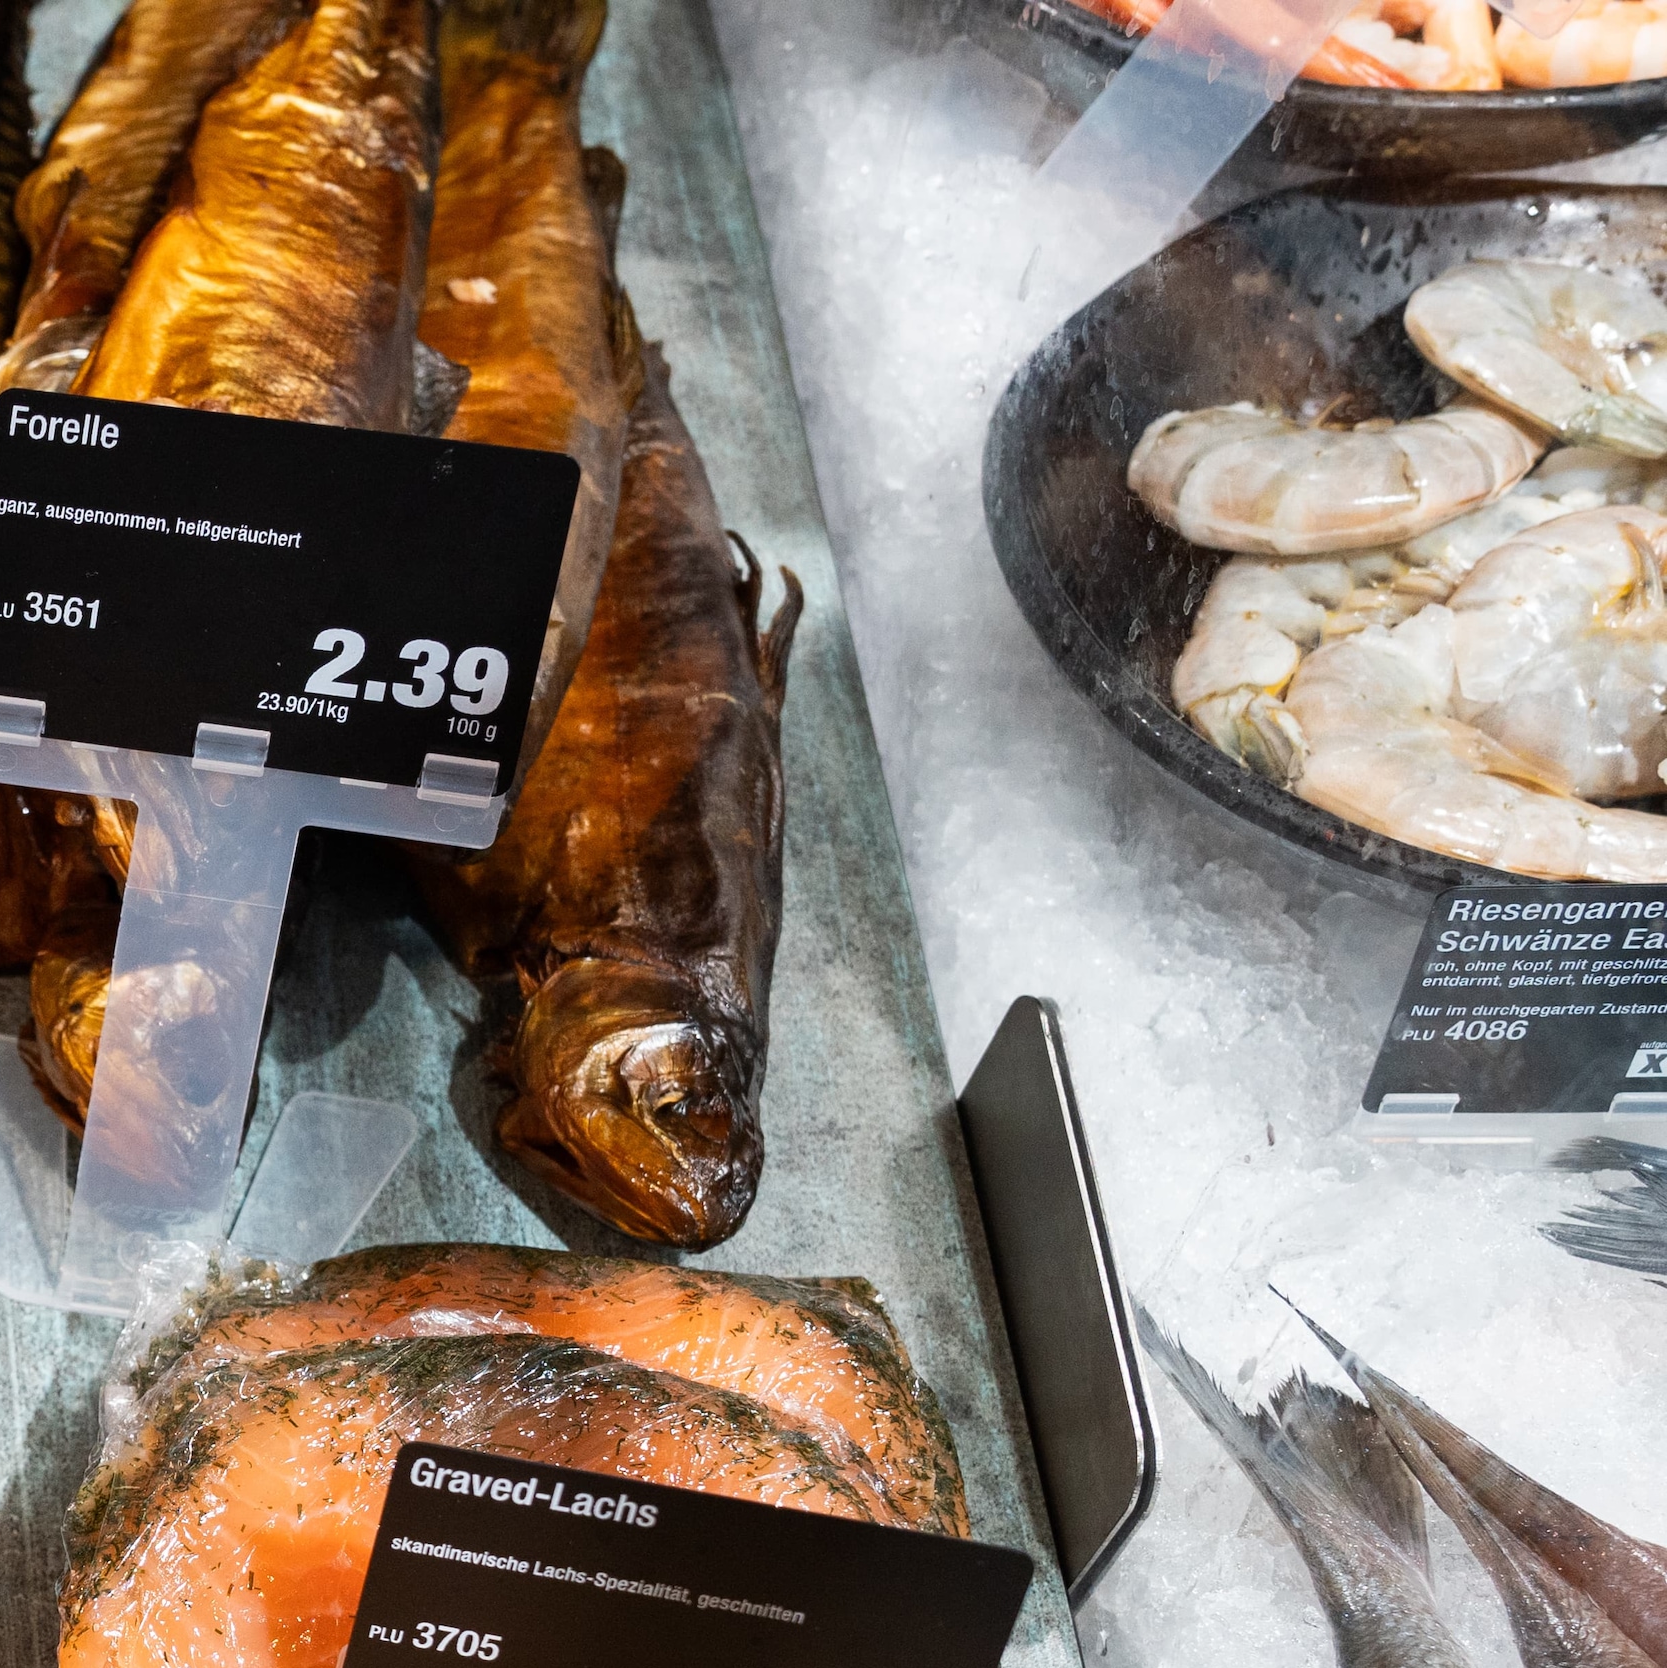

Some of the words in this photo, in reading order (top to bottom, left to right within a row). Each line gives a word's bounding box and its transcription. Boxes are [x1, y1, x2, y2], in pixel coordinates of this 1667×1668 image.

[9, 404, 120, 449] Forelle
[44, 504, 171, 535] ausgenommen,
[175, 516, 302, 549] heißgeräuchert
[23, 591, 100, 630] 3561
[303, 627, 509, 716] 2.39
[256, 691, 349, 724] 23.90/1kg
[447, 716, 480, 737] 100
[484, 724, 498, 743] g
[1447, 898, 1667, 926] Riesengarne
[1436, 928, 1612, 953] Schwänze
[1421, 974, 1503, 987] entdarmt,
[1507, 973, 1576, 989] glasiert,
[1425, 960, 1459, 975] roh,
[1464, 959, 1508, 972] ohne
[1511, 959, 1553, 973] Kopf,
[1558, 958, 1589, 971] mit
[1410, 1004, 1443, 1017] Nur
[1445, 1004, 1467, 1016] im
[1471, 1004, 1596, 1018] durchgegarten
[1401, 1027, 1436, 1041] PLU
[1443, 1019, 1529, 1041] 4086
[409, 1457, 658, 1528] Graved-Lachs
[390, 1536, 530, 1574] skandinavische
[532, 1560, 693, 1603] Lachs-Spezialität,
[697, 1594, 805, 1624] geschnitten
[368, 1624, 405, 1644] PLU
[412, 1621, 503, 1661] 3705
